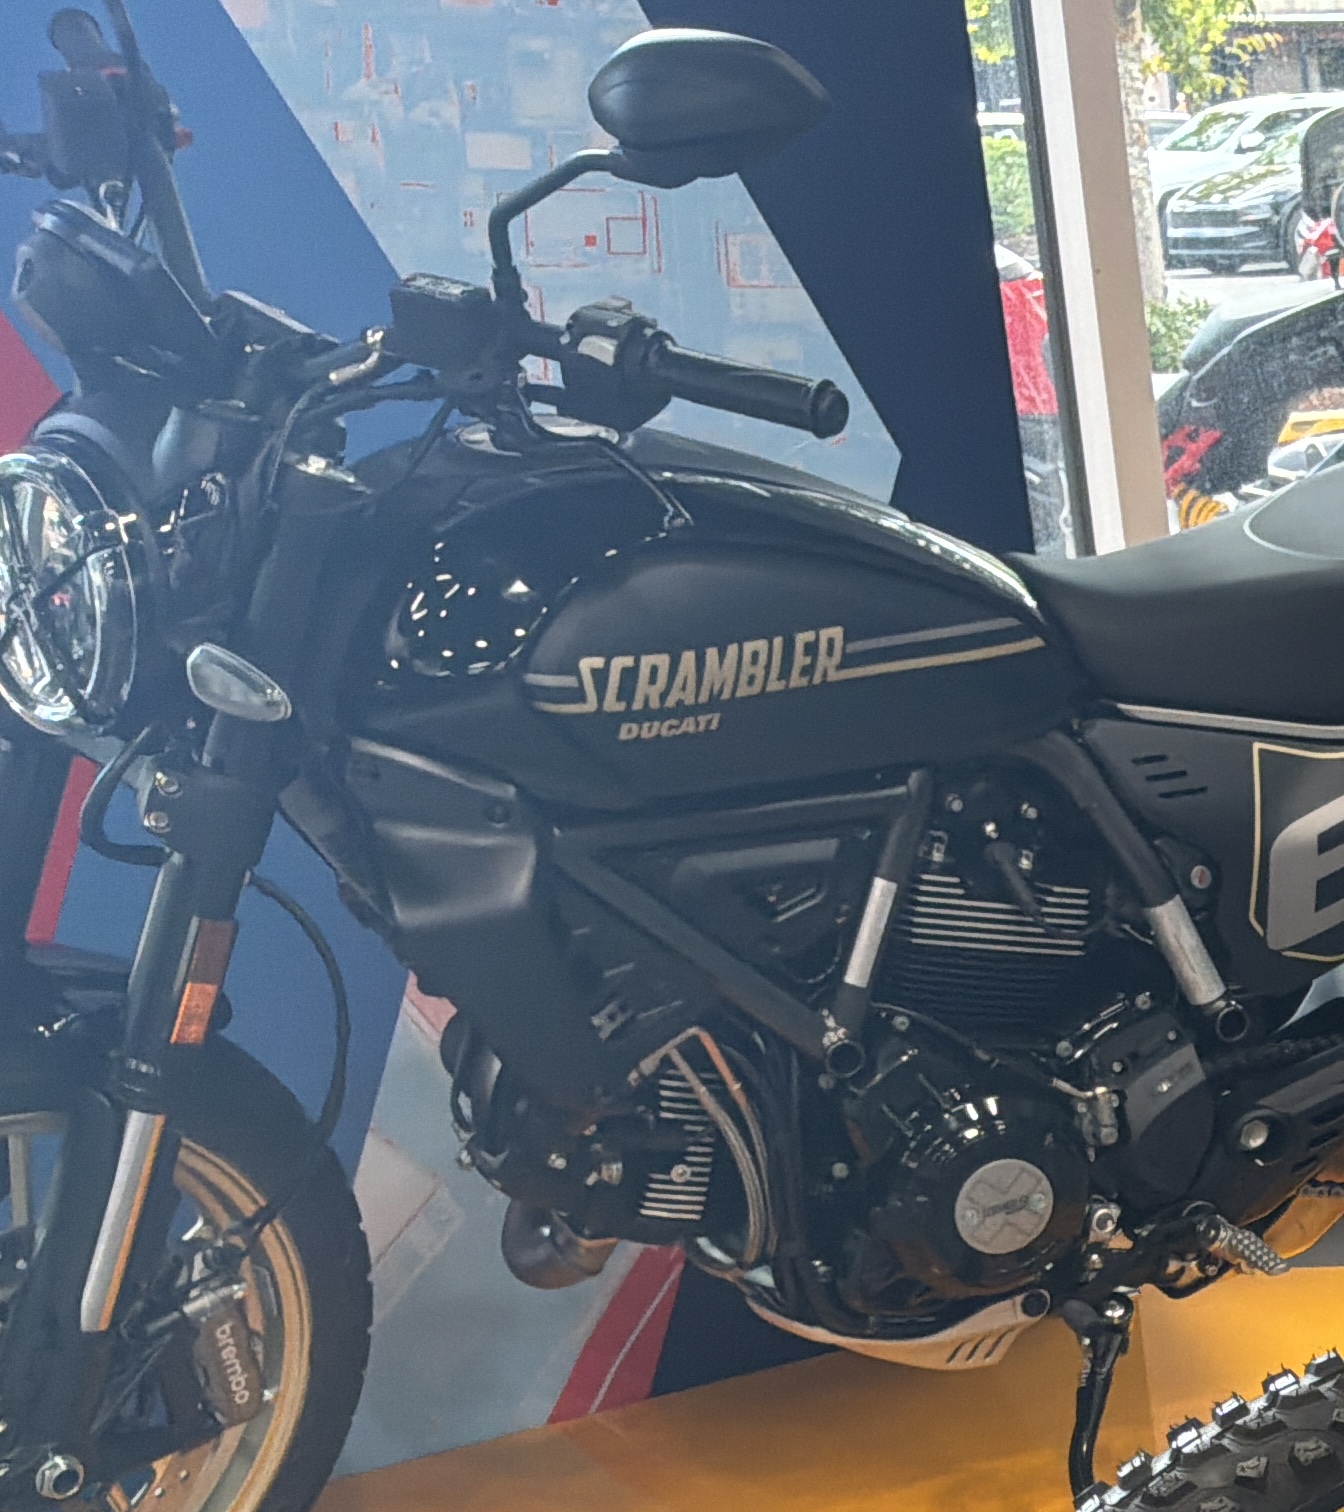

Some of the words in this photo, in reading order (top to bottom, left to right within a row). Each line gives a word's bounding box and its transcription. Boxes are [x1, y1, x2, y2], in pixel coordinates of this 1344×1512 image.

[578, 625, 846, 713] SCRAMBLER
[618, 712, 722, 741] DUCATI
[215, 1321, 250, 1405] brembo
